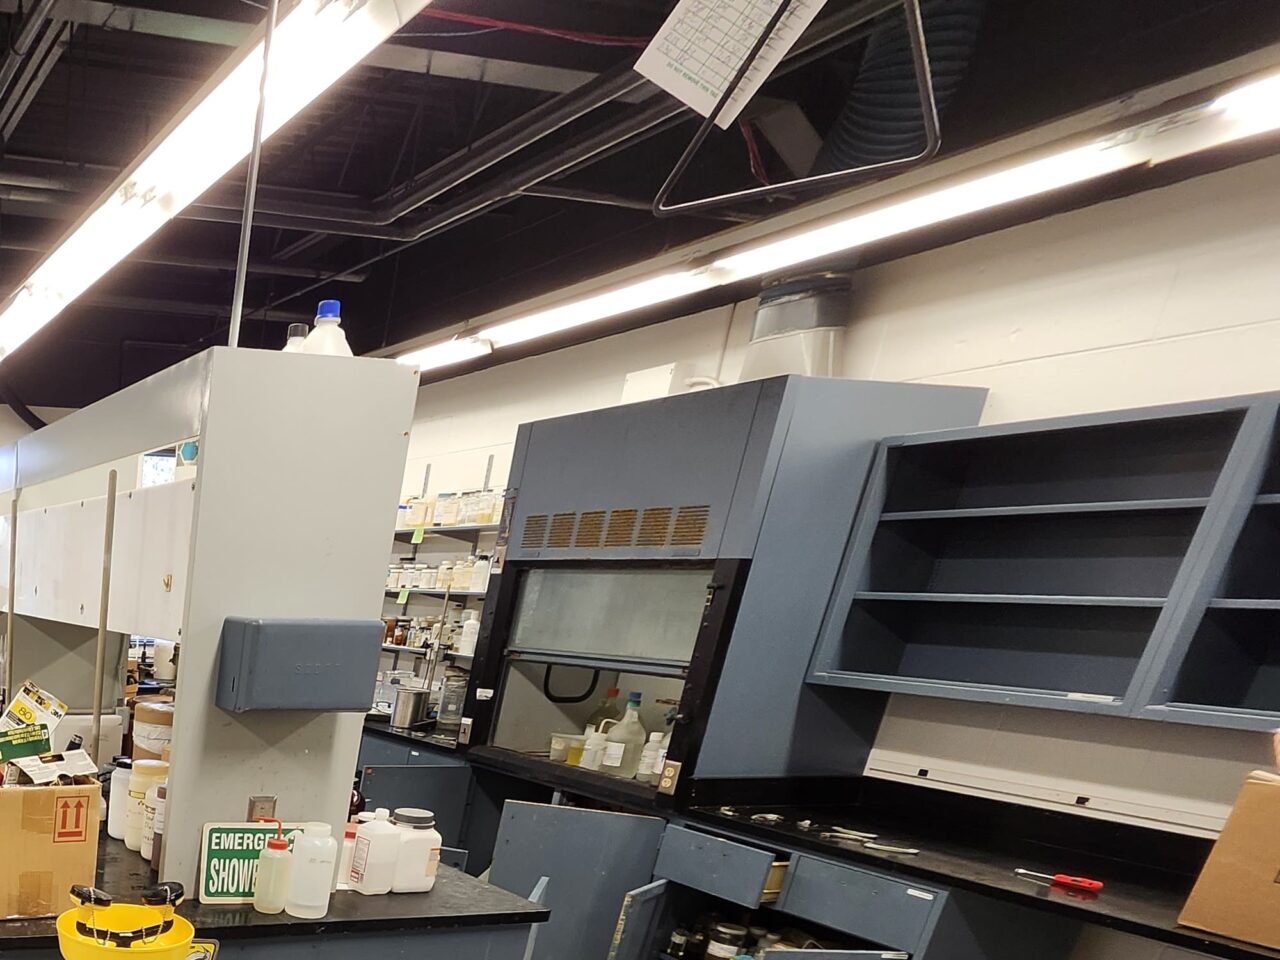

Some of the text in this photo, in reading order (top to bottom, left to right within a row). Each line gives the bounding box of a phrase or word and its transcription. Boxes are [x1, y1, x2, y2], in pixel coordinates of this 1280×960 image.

[19, 706, 32, 720] 80
[51, 708, 62, 719] 3M
[208, 857, 258, 893] SHOWE
